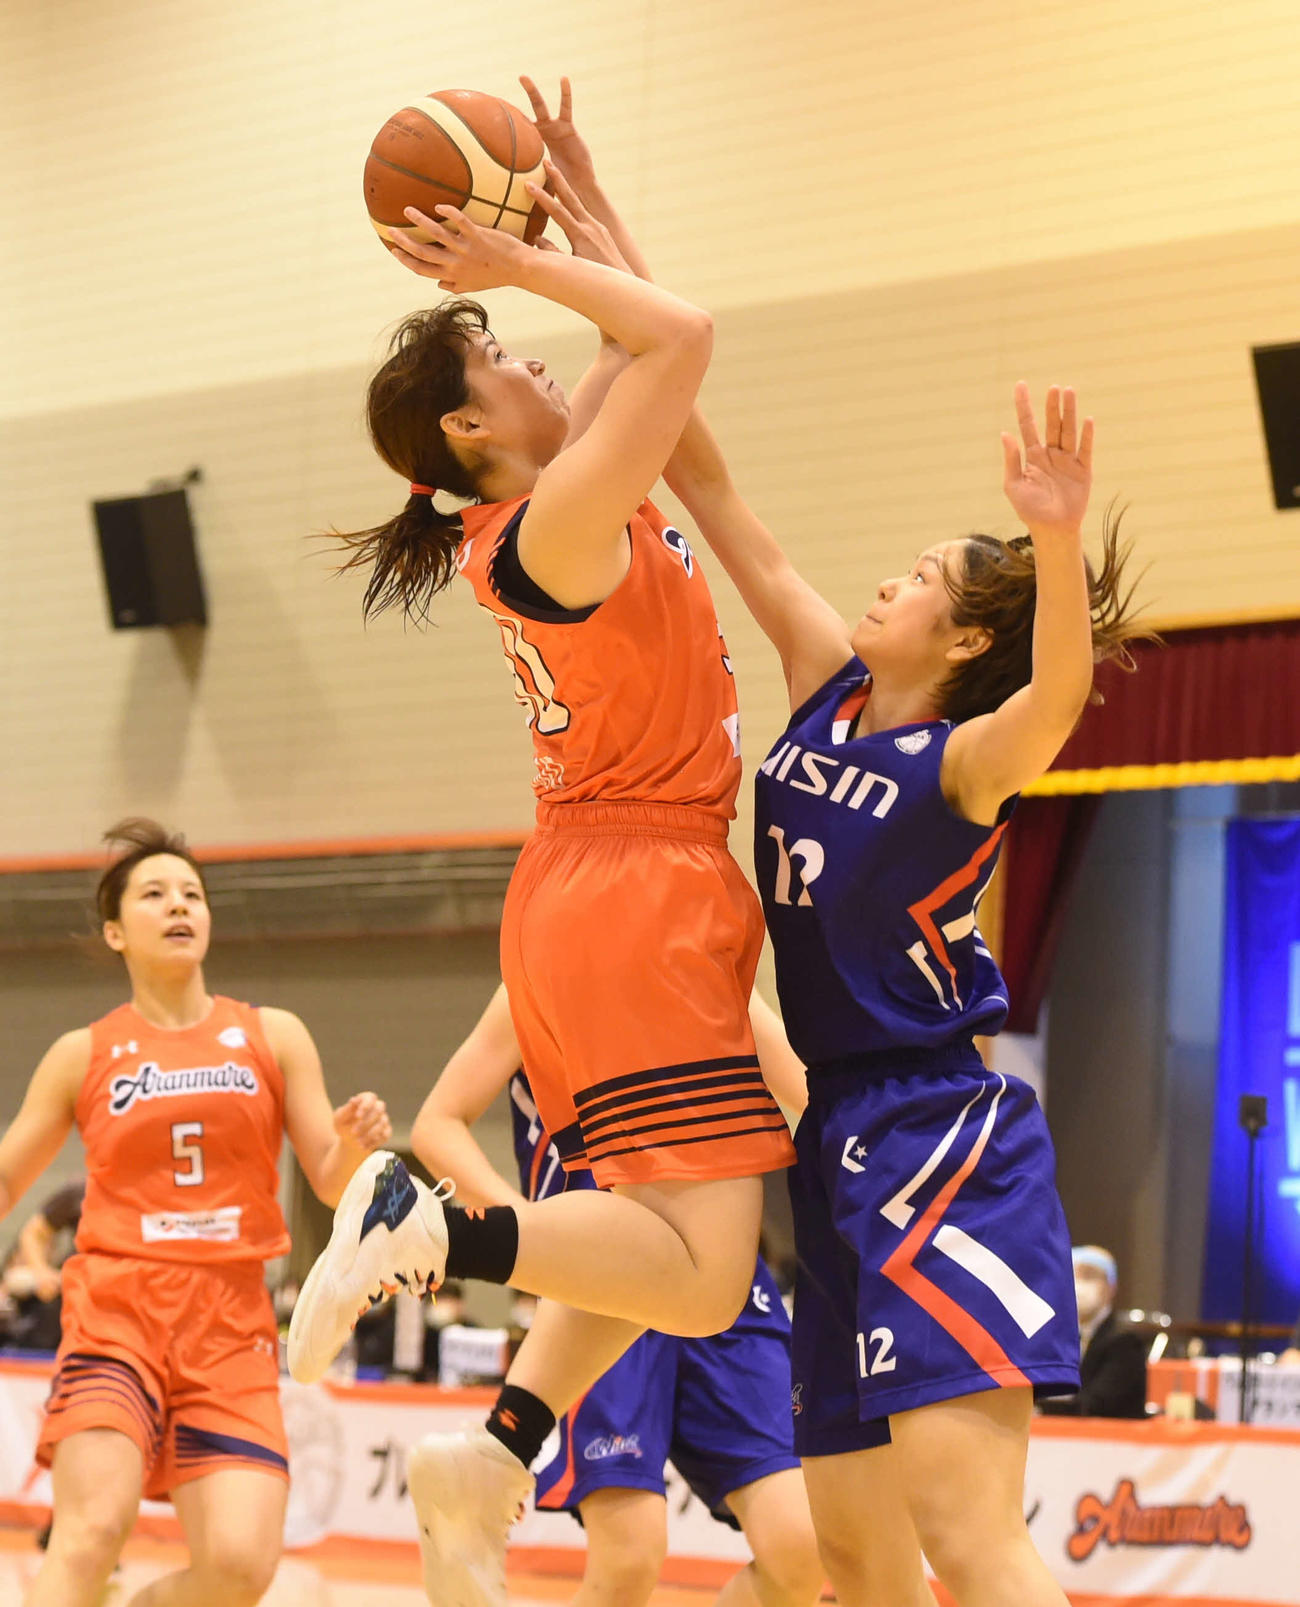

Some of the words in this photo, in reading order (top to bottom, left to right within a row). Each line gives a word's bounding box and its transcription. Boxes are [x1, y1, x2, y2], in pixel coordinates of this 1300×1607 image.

[767, 824, 825, 907] 12
[110, 1063, 257, 1114] Aranmare
[171, 1121, 205, 1187] 5
[856, 1326, 897, 1378] 12
